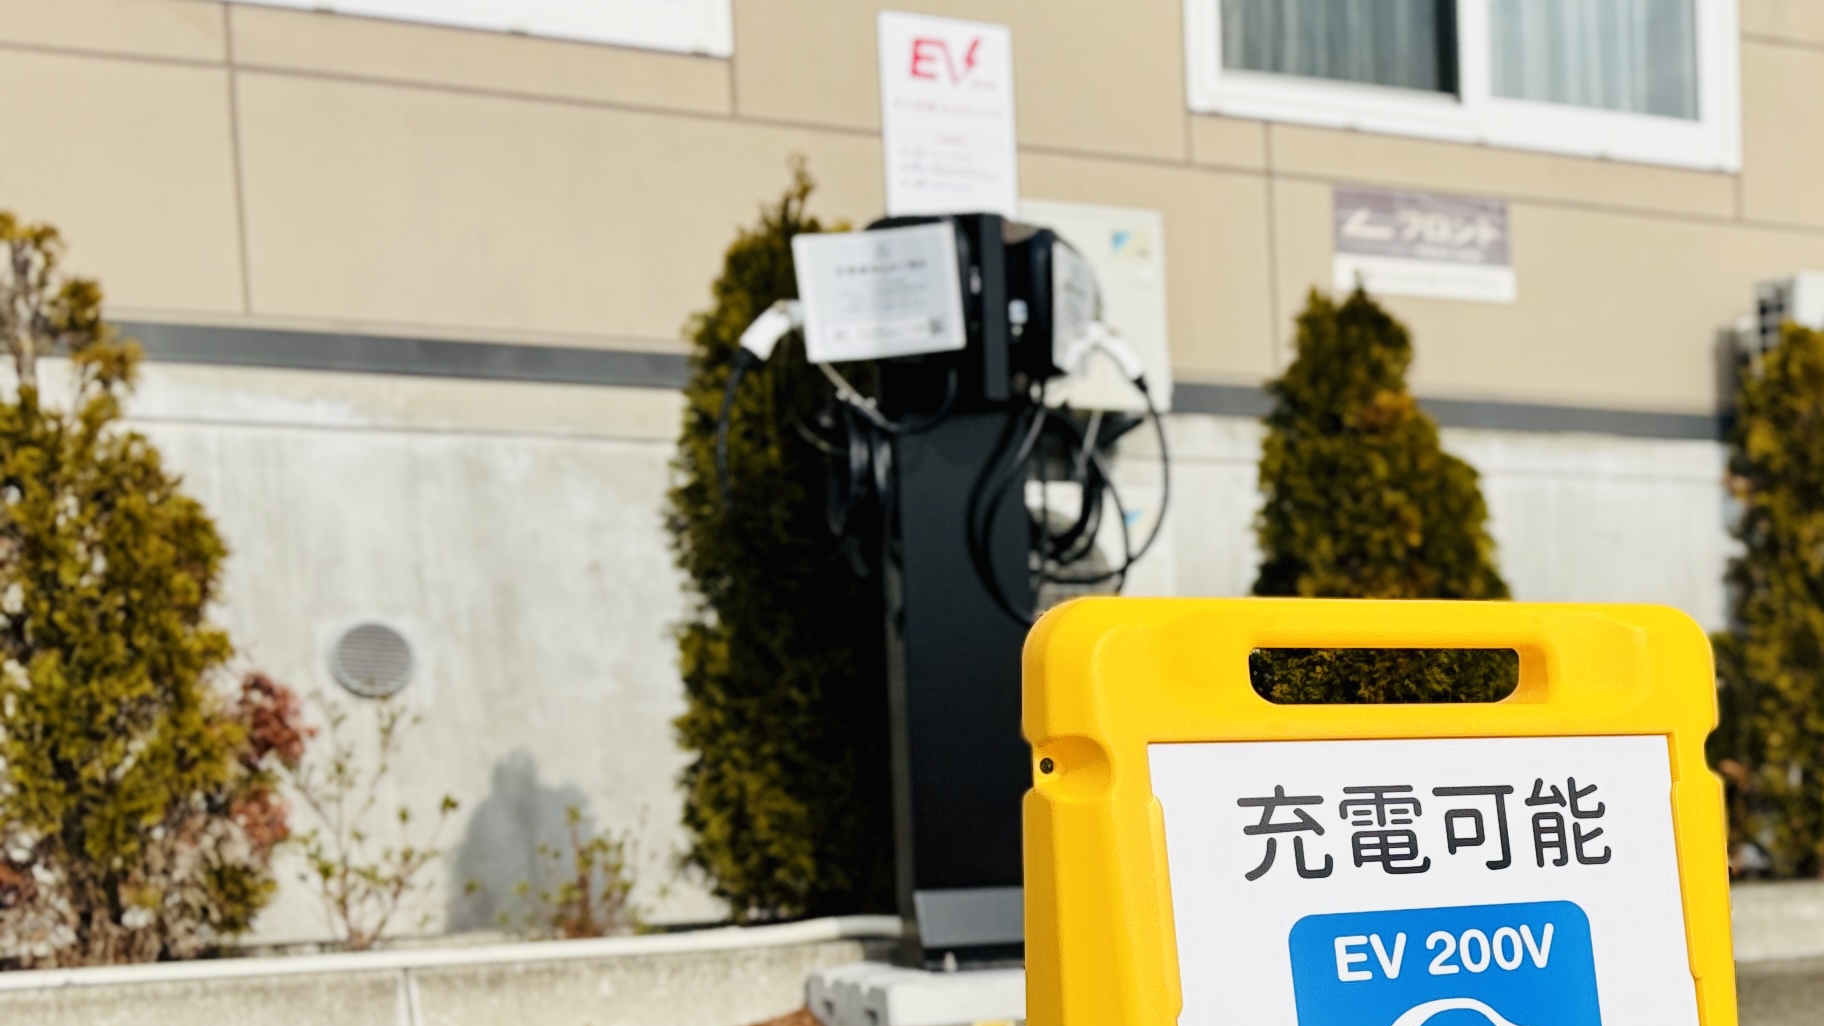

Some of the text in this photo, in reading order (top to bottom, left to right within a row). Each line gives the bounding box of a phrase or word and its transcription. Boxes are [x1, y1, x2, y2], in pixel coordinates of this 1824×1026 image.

[911, 36, 979, 85] EV
[1237, 777, 1611, 881] 充電可能
[1334, 923, 1554, 981] EV 200V
